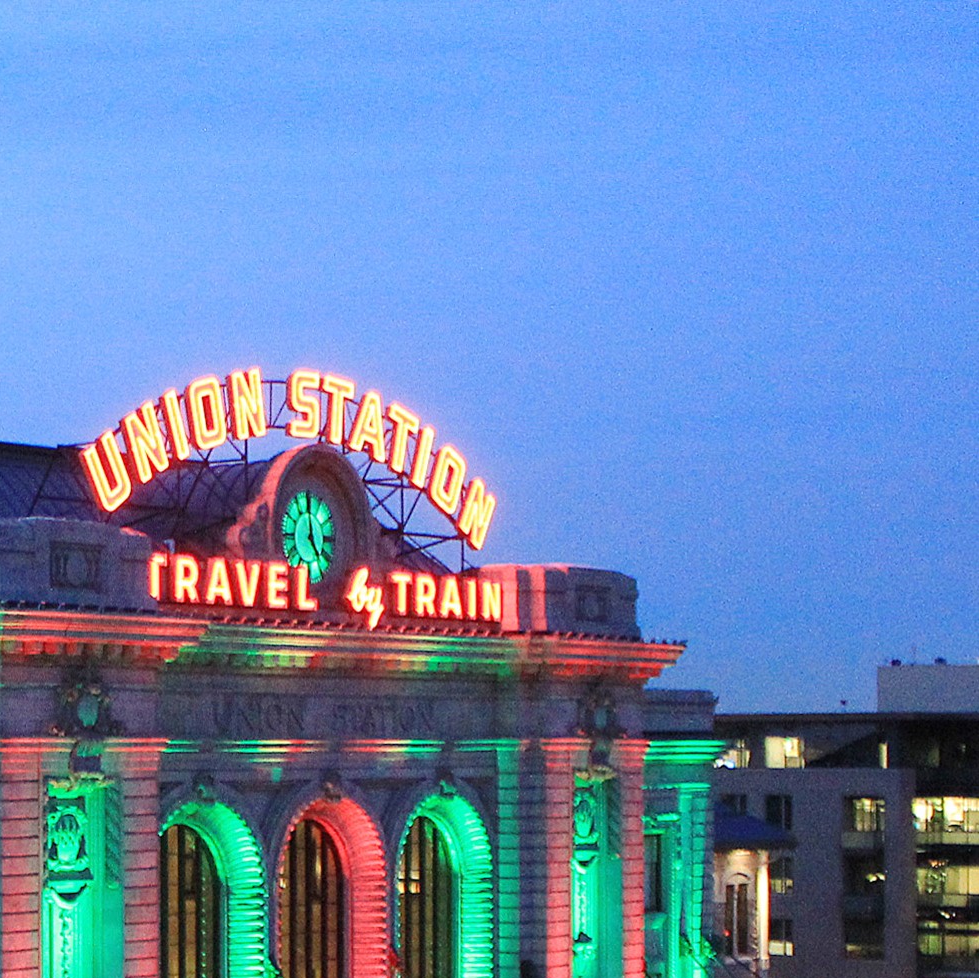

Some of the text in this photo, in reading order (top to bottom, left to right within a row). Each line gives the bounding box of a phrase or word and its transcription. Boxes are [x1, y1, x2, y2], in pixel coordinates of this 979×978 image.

[81, 366, 497, 552] UNION STATION
[148, 551, 504, 631] TRAVEL by TRAIN
